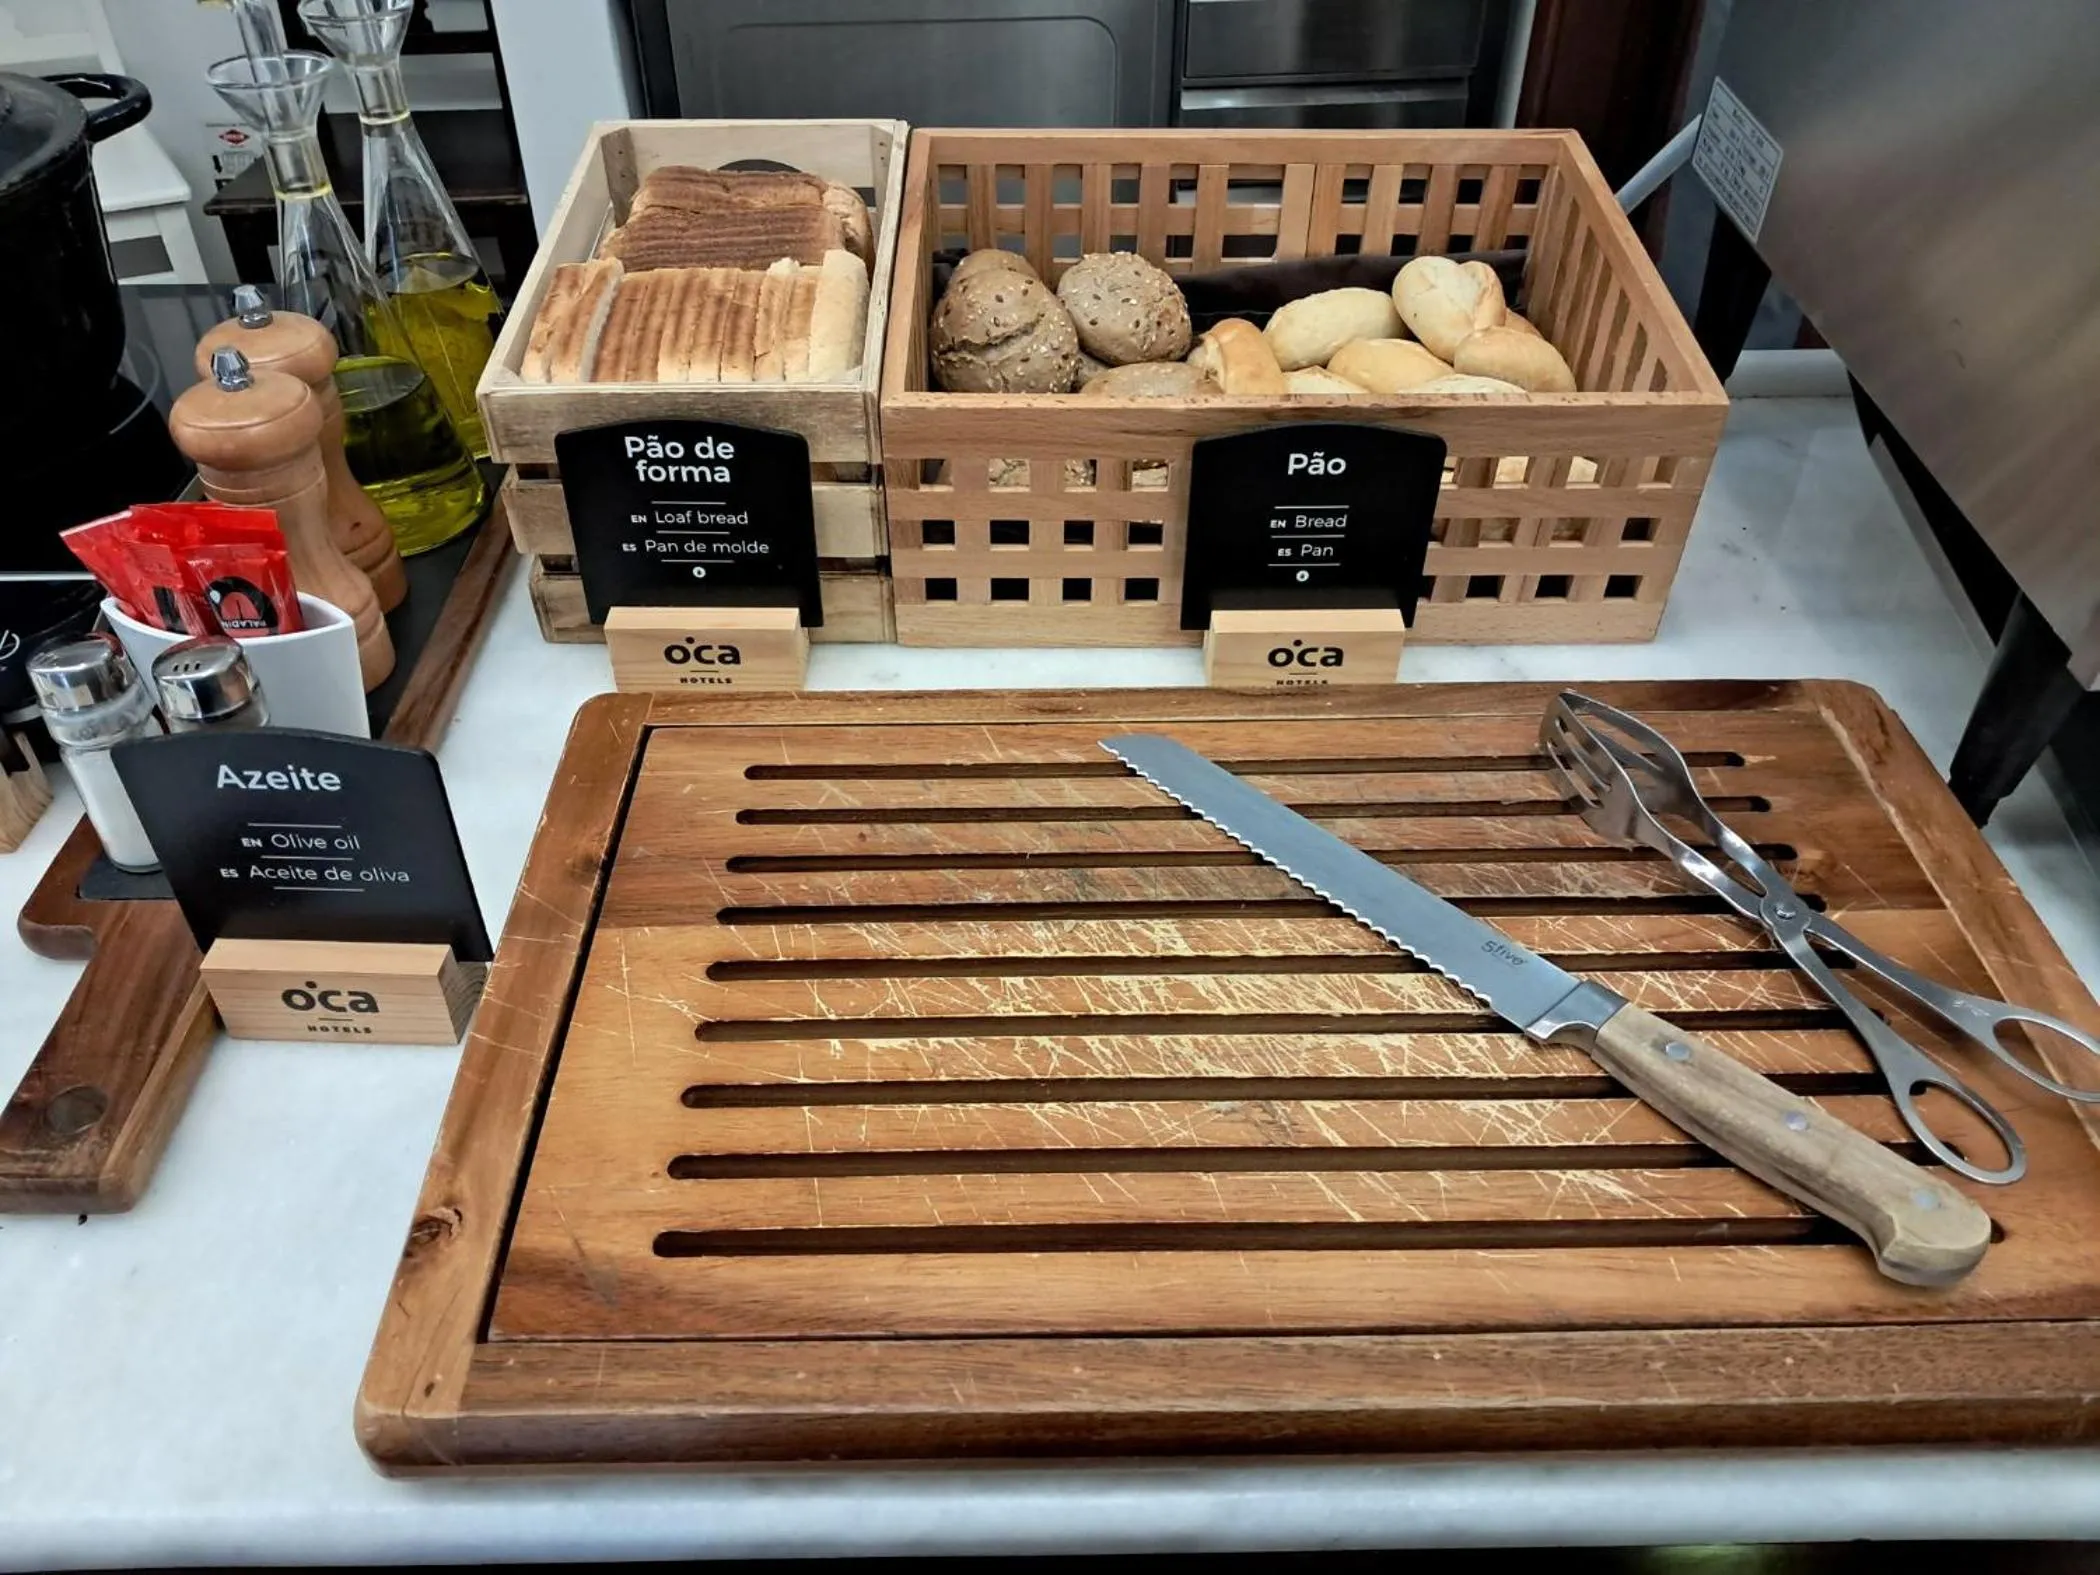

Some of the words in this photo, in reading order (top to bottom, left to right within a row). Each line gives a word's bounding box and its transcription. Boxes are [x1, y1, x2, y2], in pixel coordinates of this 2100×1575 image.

[624, 434, 685, 459] Pão
[694, 436, 735, 460] de
[635, 459, 731, 482] forma
[1287, 452, 1347, 475] Pão
[631, 514, 647, 524] EN
[654, 510, 692, 524] Loaf
[697, 511, 748, 525] bread
[1270, 520, 1286, 528] EN
[1294, 515, 1347, 529] Bread
[622, 543, 637, 552] ES
[644, 539, 678, 553] Pan
[684, 540, 707, 553] de
[713, 540, 769, 554] molde
[1277, 548, 1291, 557] ES
[1300, 544, 1334, 557] Pan
[216, 764, 341, 792] Azeite
[241, 837, 263, 848] EN
[271, 833, 327, 849] Olive
[334, 835, 361, 850] oil
[219, 868, 239, 878] ES
[250, 865, 318, 881] Aceite
[324, 866, 352, 881] de
[359, 867, 410, 883] oliva
[307, 1025, 372, 1034] HOTELS
